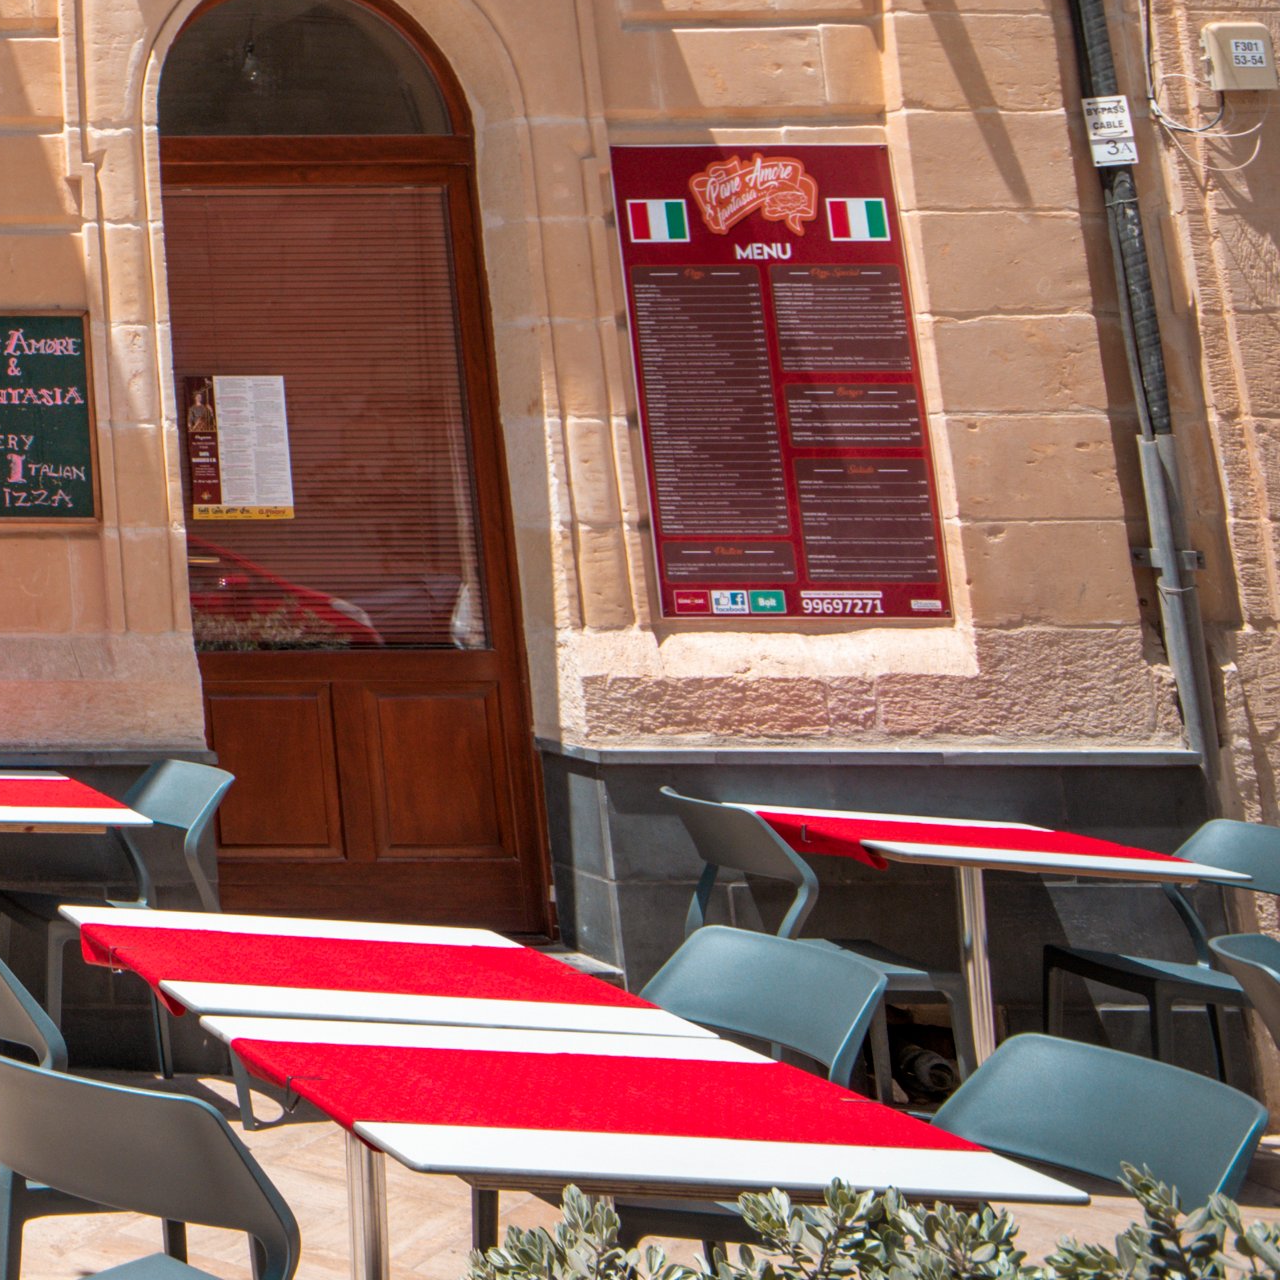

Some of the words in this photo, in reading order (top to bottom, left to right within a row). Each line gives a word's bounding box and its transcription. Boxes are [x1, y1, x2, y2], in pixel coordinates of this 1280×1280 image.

[1234, 41, 1259, 52] F301
[1234, 55, 1264, 65] 53-54
[1086, 104, 1126, 117] BY-PASS
[1092, 119, 1125, 131] CABLE
[1105, 139, 1134, 156] 3A
[745, 157, 793, 190] Amore
[735, 242, 792, 260] MENU
[3, 328, 81, 357] AMORE
[6, 357, 22, 377] &
[757, 596, 777, 608] Bolt
[801, 598, 885, 614] 99697271
